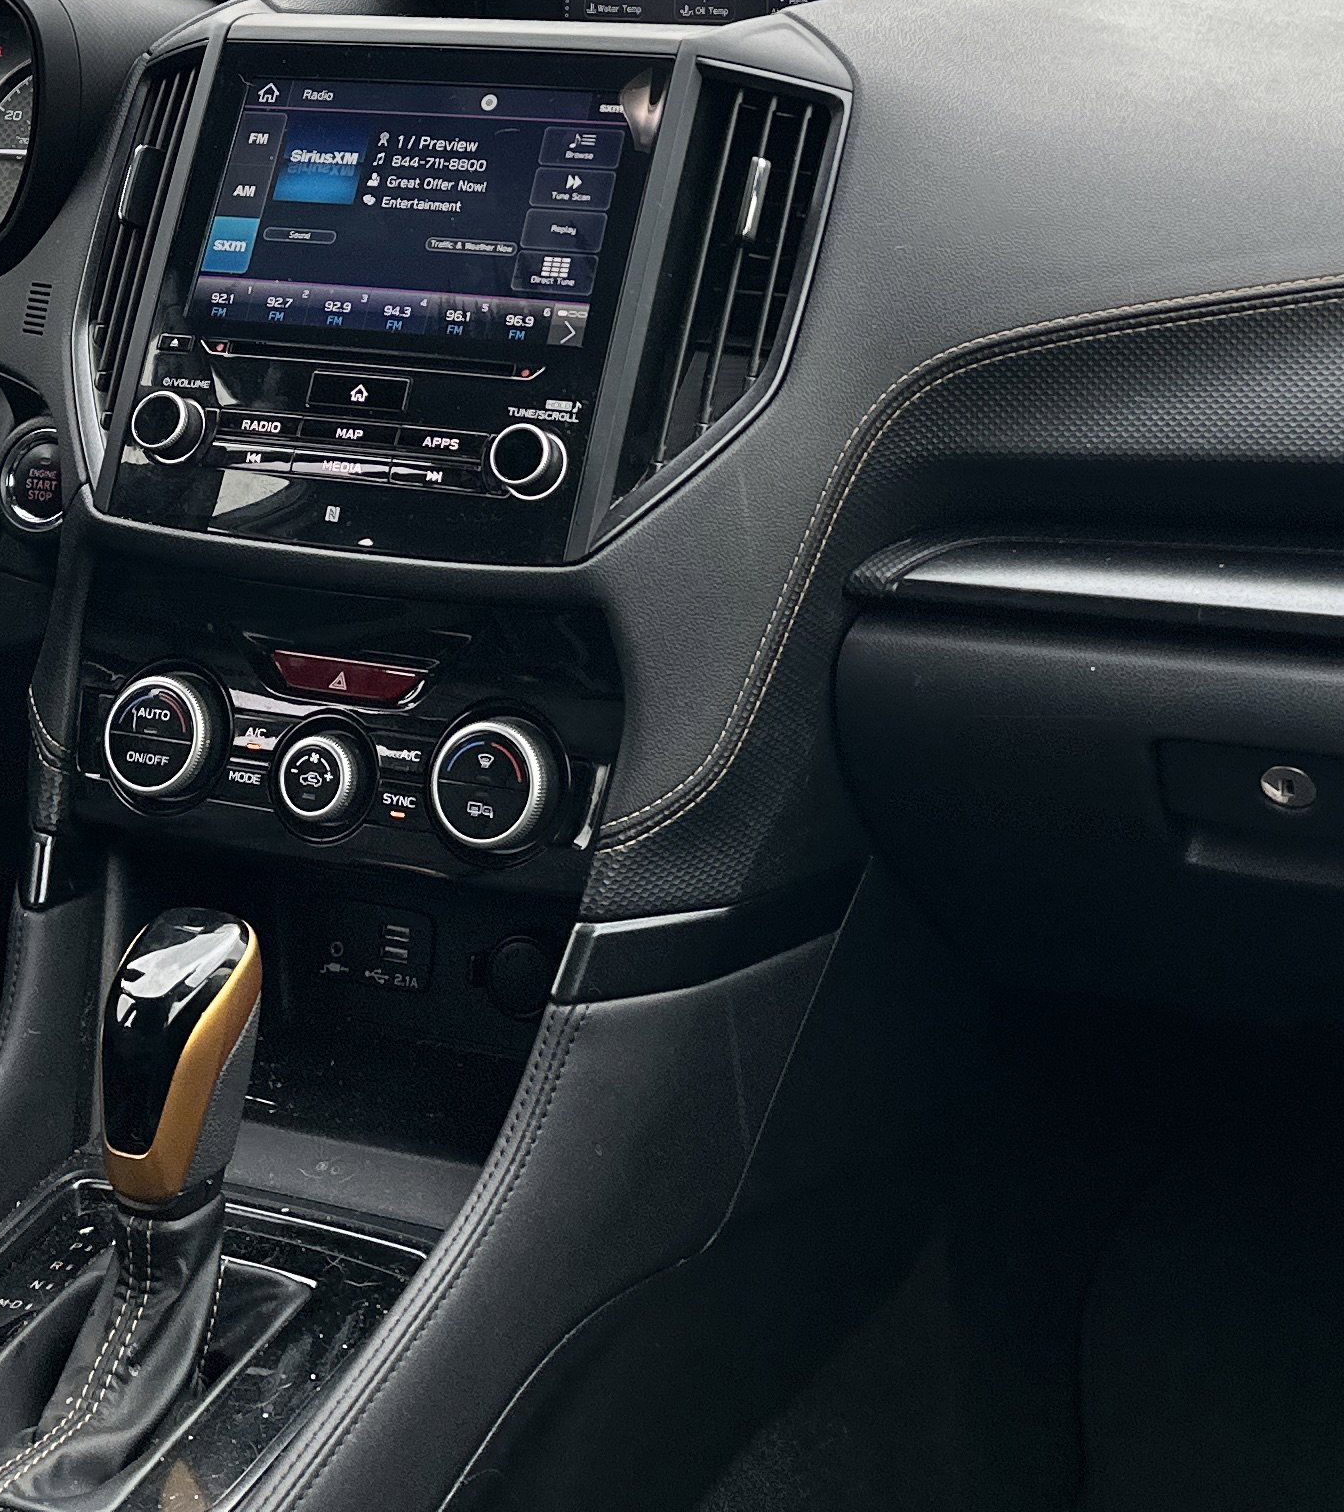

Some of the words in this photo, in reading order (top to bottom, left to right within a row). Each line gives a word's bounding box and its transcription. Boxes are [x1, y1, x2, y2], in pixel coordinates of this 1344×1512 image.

[303, 89, 334, 101] Radio
[5, 110, 23, 121] 20
[248, 133, 269, 145] FM
[419, 137, 478, 153] Preview
[290, 149, 359, 165] SiriusXM
[391, 155, 487, 172] 844-711-8800
[386, 176, 419, 189] Great
[423, 178, 454, 191] Offer
[457, 180, 487, 193] Now!
[233, 185, 256, 197] AM
[381, 196, 462, 213] Entertainment
[213, 240, 246, 252] sxm
[211, 293, 235, 304] 92.1
[266, 297, 294, 308] 92.7
[211, 306, 226, 318] FM
[325, 301, 352, 313] 92.9
[383, 305, 411, 318] 94.3
[268, 311, 284, 321] FM
[326, 315, 343, 326] FM
[446, 310, 471, 322] 96.1
[505, 315, 535, 327] 96.9
[386, 320, 402, 330] FM
[447, 325, 463, 335] FM
[509, 330, 525, 341] FM
[508, 406, 579, 423] TUNE/SCROLL
[241, 419, 281, 433] RADIO
[336, 428, 364, 440] MAP
[422, 436, 460, 450] APPS
[322, 460, 362, 474] MEDIA
[26, 479, 57, 490] START
[28, 490, 53, 501] STOP
[138, 707, 170, 721] AUTO
[245, 727, 267, 738] A/C
[126, 751, 170, 766] ON/OFF
[228, 770, 262, 785] MODE
[382, 792, 416, 808] SYNC
[394, 973, 418, 988] 2.1A
[50, 1261, 64, 1270] R
[30, 1280, 44, 1290] N
